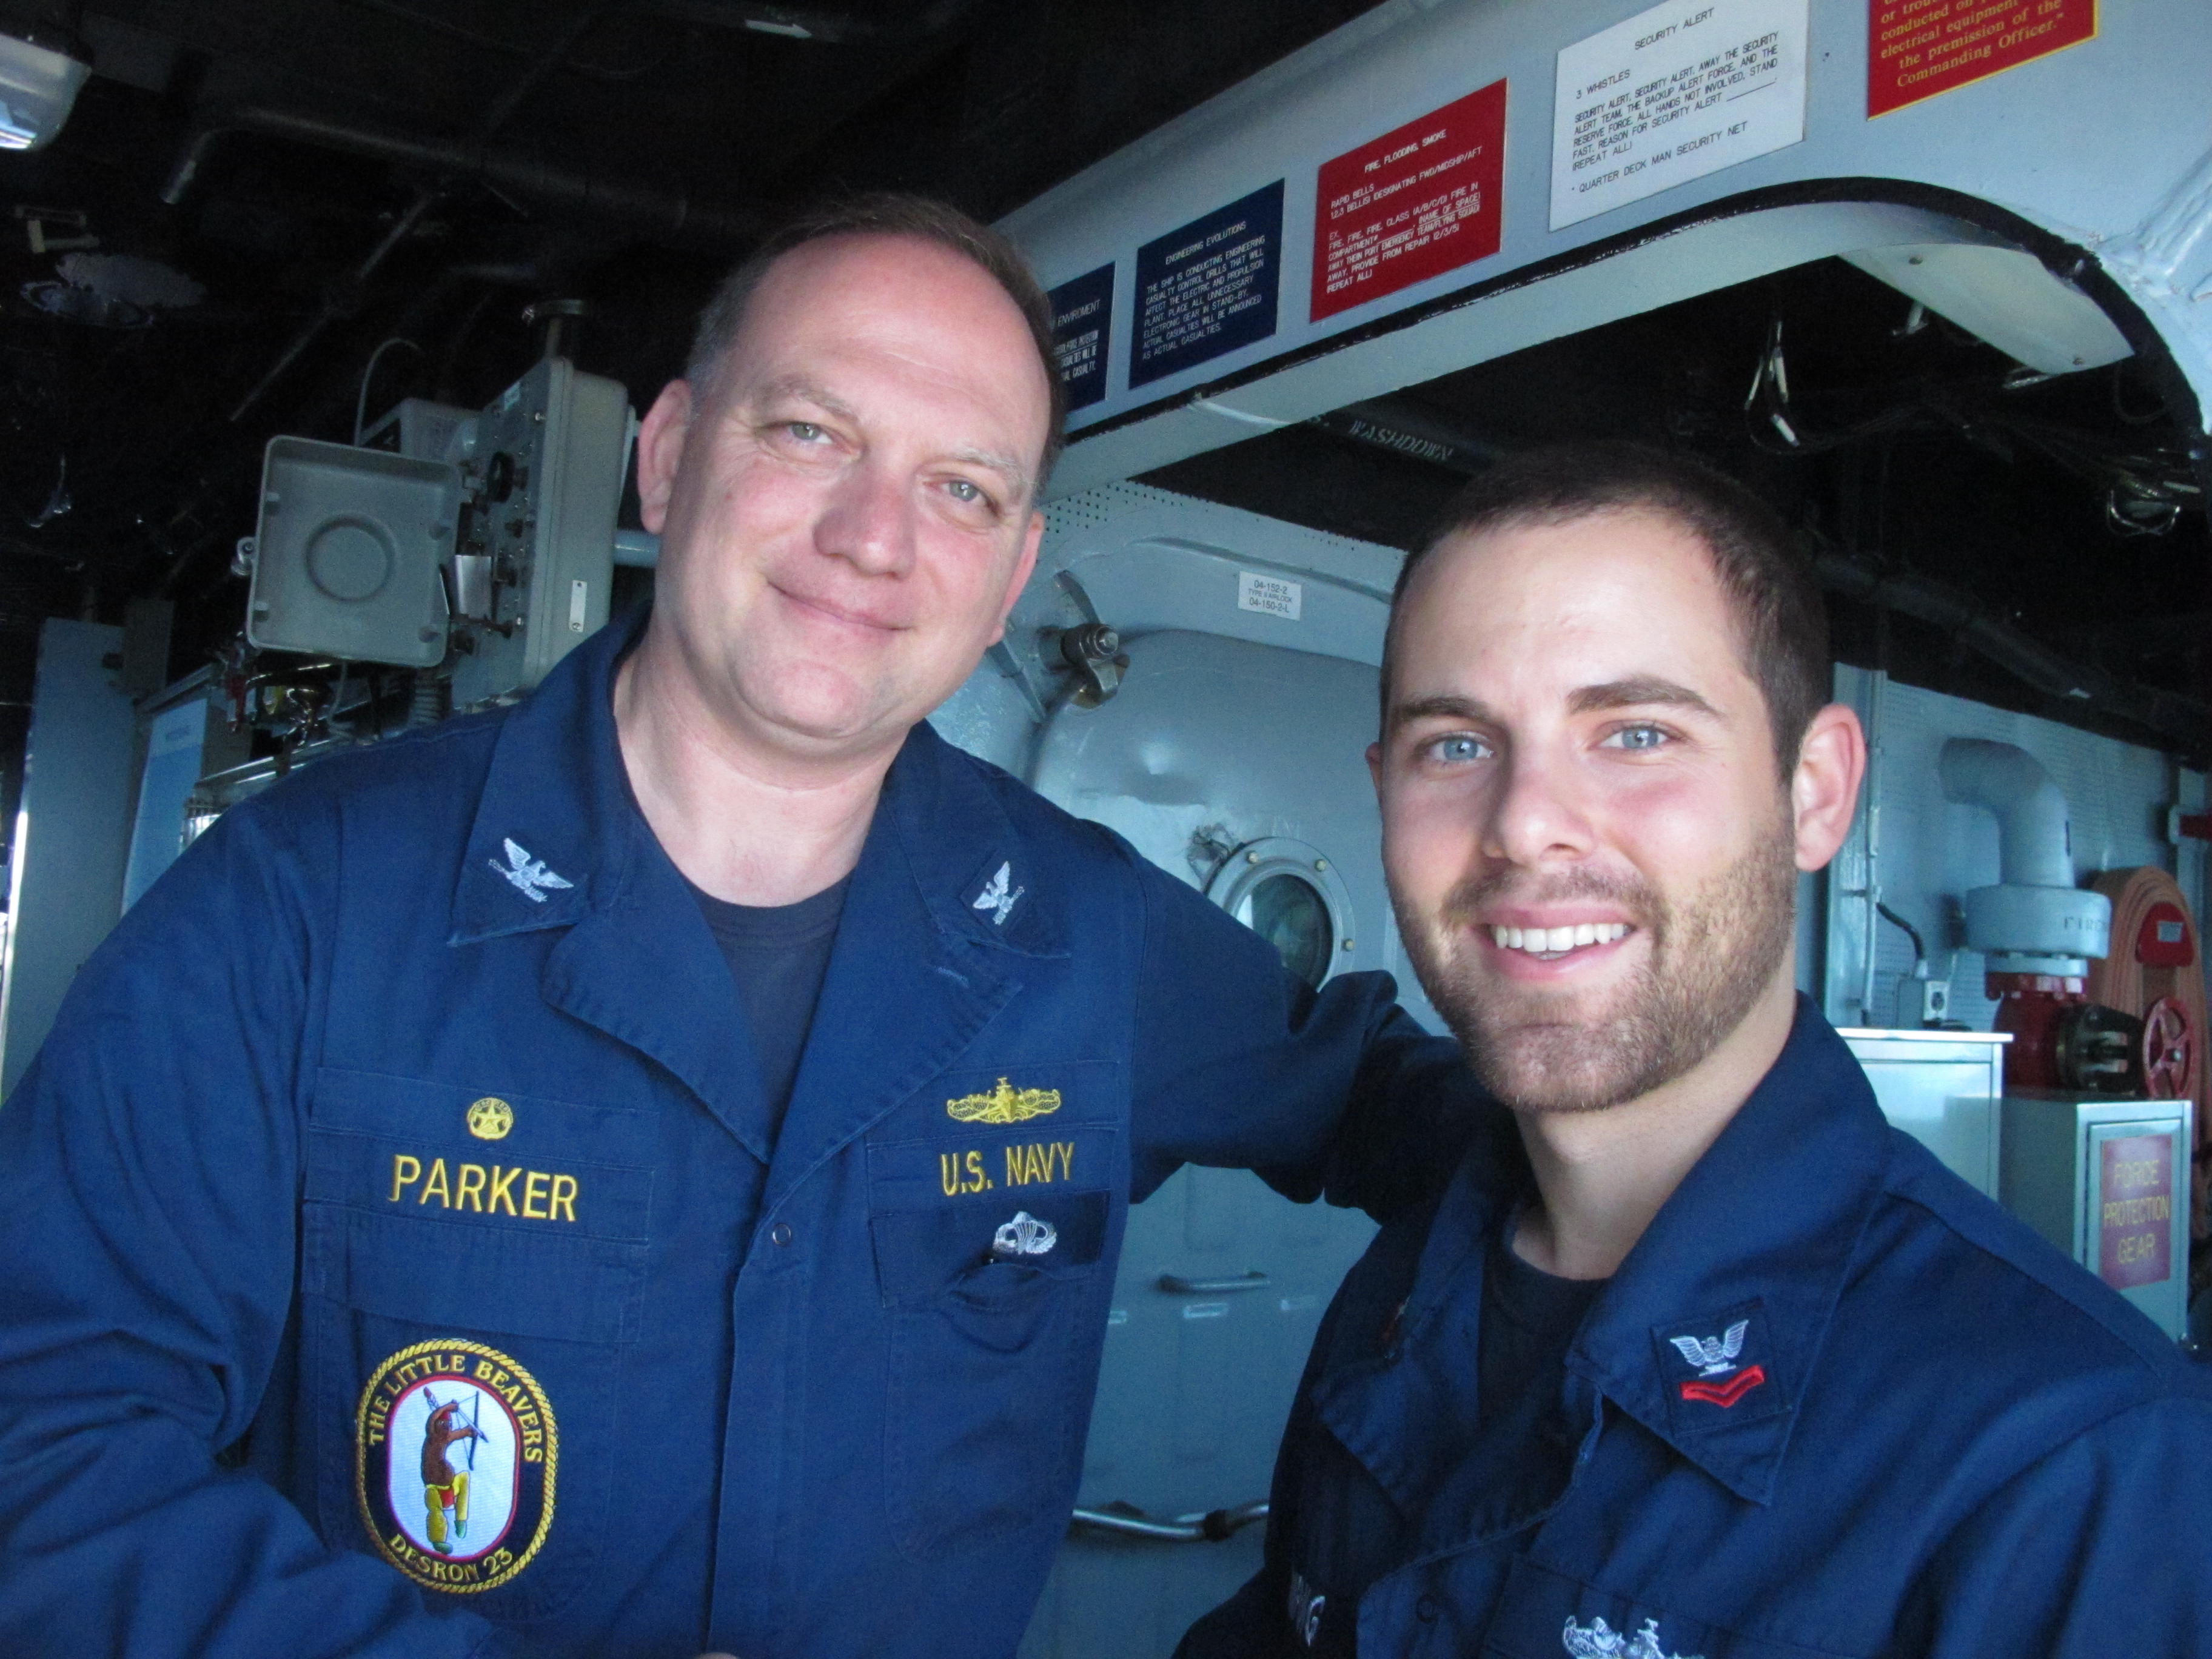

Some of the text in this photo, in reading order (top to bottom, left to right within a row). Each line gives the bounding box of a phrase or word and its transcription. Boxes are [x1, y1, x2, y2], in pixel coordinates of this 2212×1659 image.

[1635, 7, 1714, 50] SECURITY ALERT
[1881, 11, 1896, 24] or
[1881, 4, 1949, 41] conducted
[1899, 0, 2062, 69] the premission of the
[1881, 26, 1940, 58] electrical
[1575, 102, 1604, 123] SECURITY
[1608, 92, 1631, 109] ALERT,
[1634, 78, 1666, 98] SECURITY
[1698, 55, 1720, 72] AWAY
[1724, 47, 1738, 61] THE
[1742, 31, 1778, 55] SECURITY
[1576, 69, 1630, 99] 3 WHISTLES
[1897, 44, 1991, 87] Commanding
[1574, 118, 1597, 135] ALERT
[1627, 99, 1641, 113] THE
[1644, 86, 1674, 106] BACKUP
[1678, 75, 1703, 92] ALERT
[1740, 53, 1757, 67] AND
[1762, 44, 1777, 59] THE
[1574, 127, 1604, 147] RESERVE
[1637, 108, 1651, 121] ALL
[1655, 96, 1680, 114] HANDS
[1684, 88, 1700, 102] NOT
[1749, 57, 1777, 76] STAND
[1422, 129, 1446, 147] SMOKE
[1598, 129, 1627, 150] REASON
[1632, 122, 1646, 136] FOR
[1651, 105, 1689, 128] SECURITY
[1695, 92, 1721, 111] ALERT
[1579, 121, 1747, 193] QUARTER DECK MAN SECURITY NET
[1331, 183, 1373, 209] RAPID BELLS
[1386, 210, 1409, 227] CLASS
[1450, 185, 1467, 200] FIRE
[1470, 181, 1477, 192] IN
[1443, 204, 1450, 215] OF
[1165, 220, 1246, 265] ENGINEERING EVOLUTIONS
[1328, 259, 1343, 272] AWAY
[1364, 244, 1378, 257] PORT
[1381, 230, 1413, 250] EMERGENCY
[1351, 255, 1378, 273] PROVIDE
[1382, 246, 1401, 261] FROM
[1404, 234, 1429, 252] REPAIR
[1145, 247, 1264, 305] CASUALTY CONTROL DRILLS THAT WILL
[1147, 235, 1265, 295] THE SHIP IS CONDUCTING ENGINEERING
[1145, 258, 1264, 316] AFFECT THE ELECTRIC AND PROPULSION
[1168, 302, 1188, 317] PLACE
[1191, 295, 1203, 307] ALL
[1207, 274, 1253, 301] UNNECESSARY
[1057, 300, 1101, 327] ENVIROMENT
[1143, 293, 1261, 349] ACTUAL CASUALTIES WILL BE ANNOUNCED
[1144, 317, 1179, 338] ELECTRONIC
[1182, 308, 1199, 322] GEAR
[1203, 304, 1209, 313] IN
[1142, 350, 1150, 360] AS
[1154, 339, 1178, 356] ACTUAL
[1348, 420, 1453, 461] WASHDOWN
[1248, 588, 1262, 598] TYPE
[1269, 592, 1293, 603] AIRLOCK
[1249, 597, 1290, 614] 04-150-2-L
[1254, 580, 1288, 595] 04-152-2
[389, 1154, 578, 1222] PARKER
[941, 1142, 1075, 1196] U.S. NAVY
[2114, 1159, 2160, 1188] FORCE
[2104, 1195, 2170, 1227] PROTECTION
[2119, 1233, 2156, 1264] GEAR
[367, 1354, 543, 1464] THE LITTLE BEAVERS
[389, 1533, 514, 1581] DESRON 23
